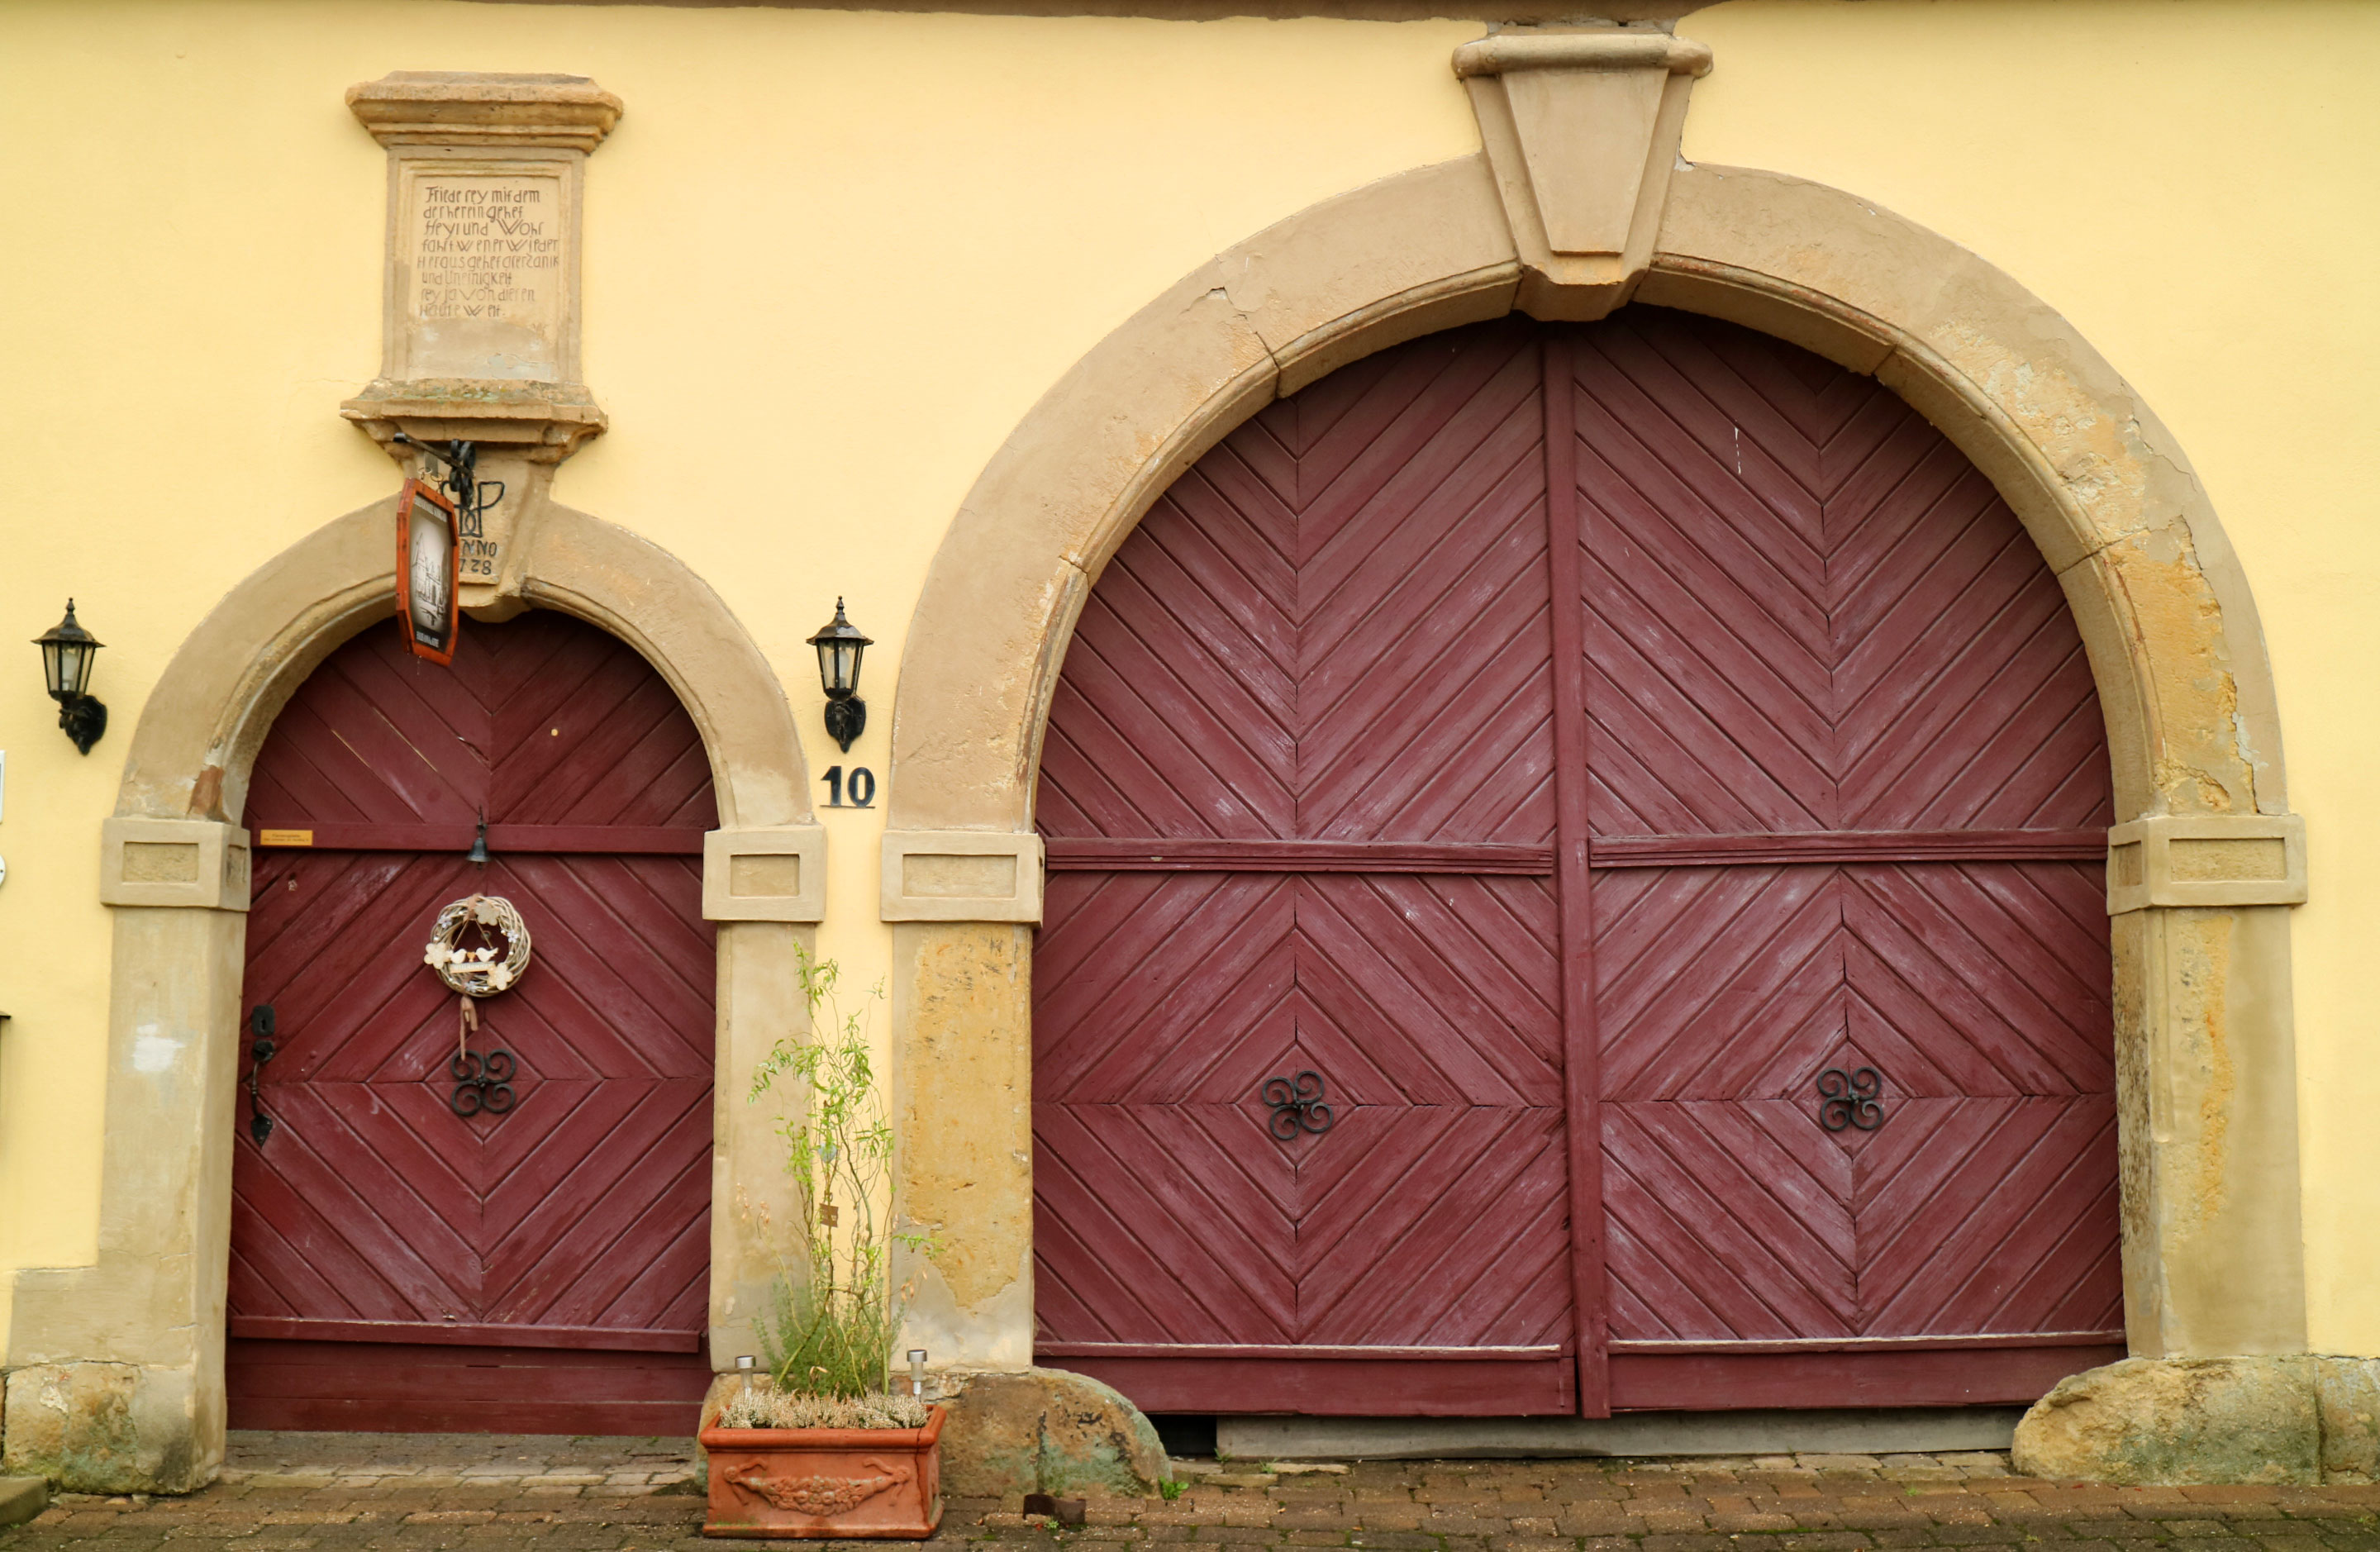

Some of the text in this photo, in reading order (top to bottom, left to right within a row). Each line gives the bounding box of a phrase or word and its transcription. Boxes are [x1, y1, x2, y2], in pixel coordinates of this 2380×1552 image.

[513, 189, 540, 203] dem
[463, 222, 488, 236] und
[422, 272, 442, 285] und
[459, 539, 497, 558] NNO
[459, 558, 493, 575] 728
[820, 765, 876, 807] 10
